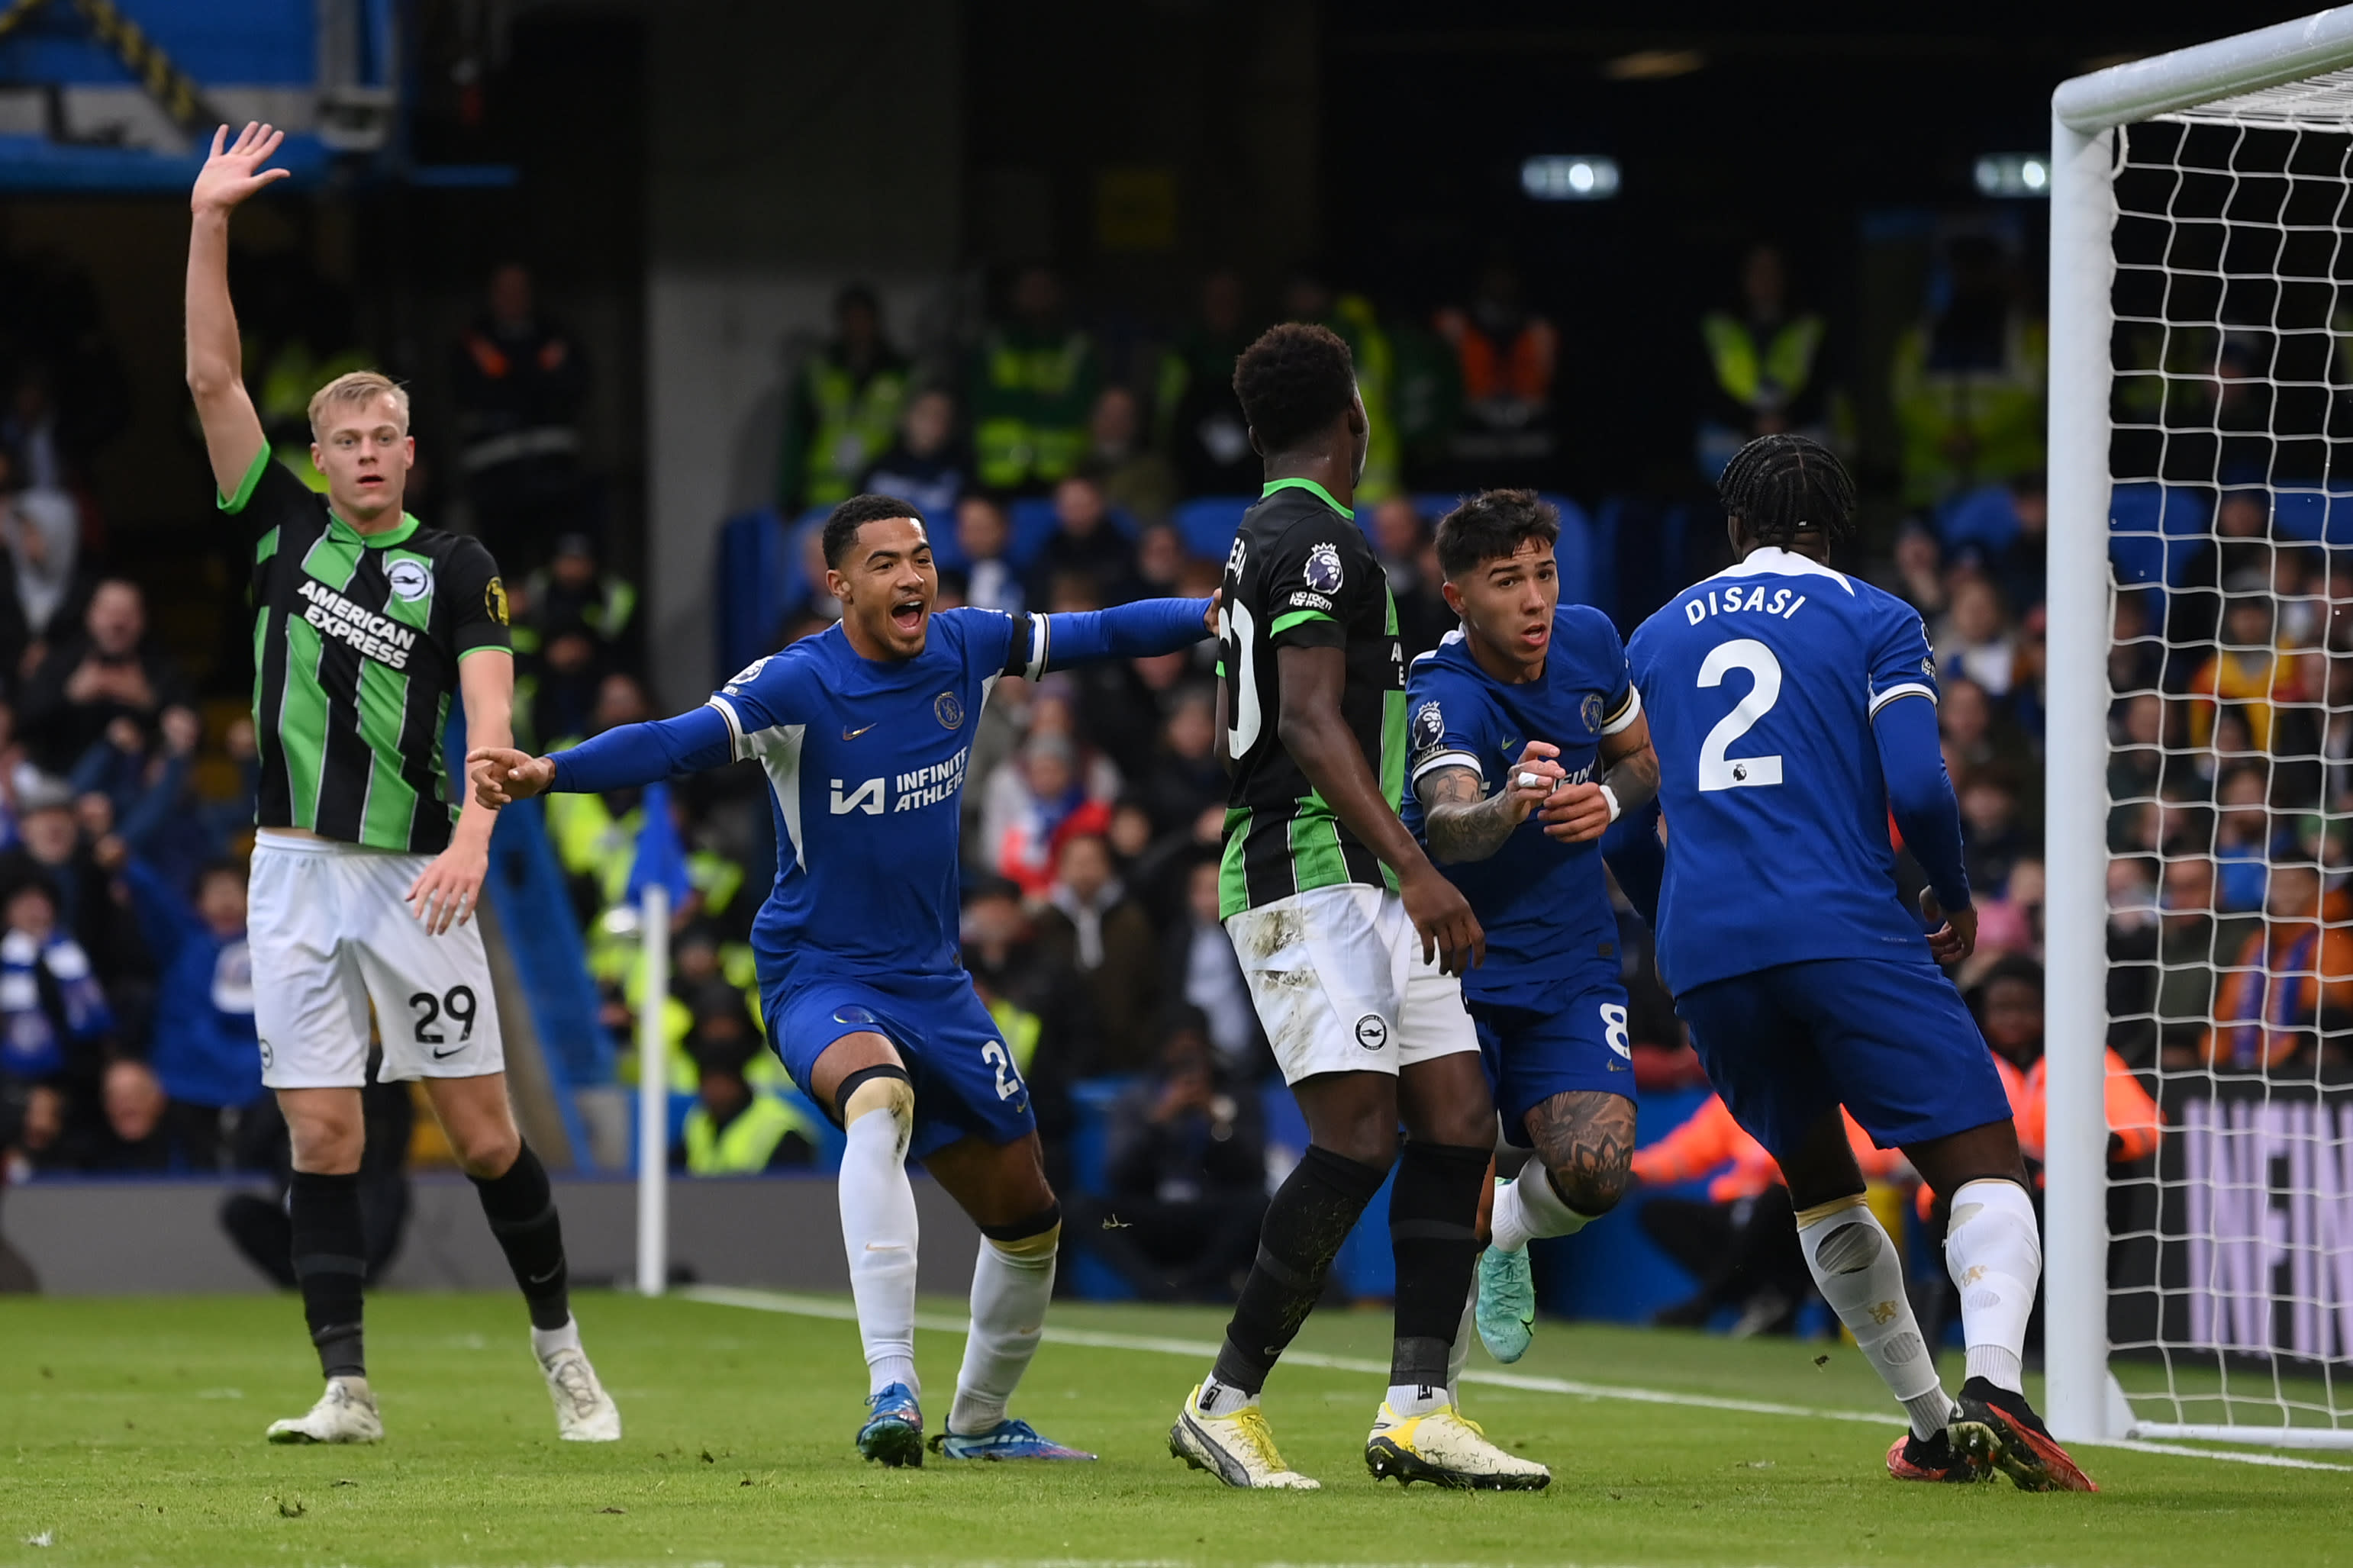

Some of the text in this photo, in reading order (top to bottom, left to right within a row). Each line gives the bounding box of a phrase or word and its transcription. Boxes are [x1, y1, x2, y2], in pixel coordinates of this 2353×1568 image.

[297, 579, 416, 651] AMERICAN
[1685, 585, 1807, 626] DISASI
[303, 604, 410, 671] EXPRESS
[1696, 638, 1783, 793] 2
[894, 768, 964, 813] ATHLETE
[896, 747, 967, 793] INFINITE
[408, 984, 476, 1044] 29
[1600, 1002, 1632, 1061] 8
